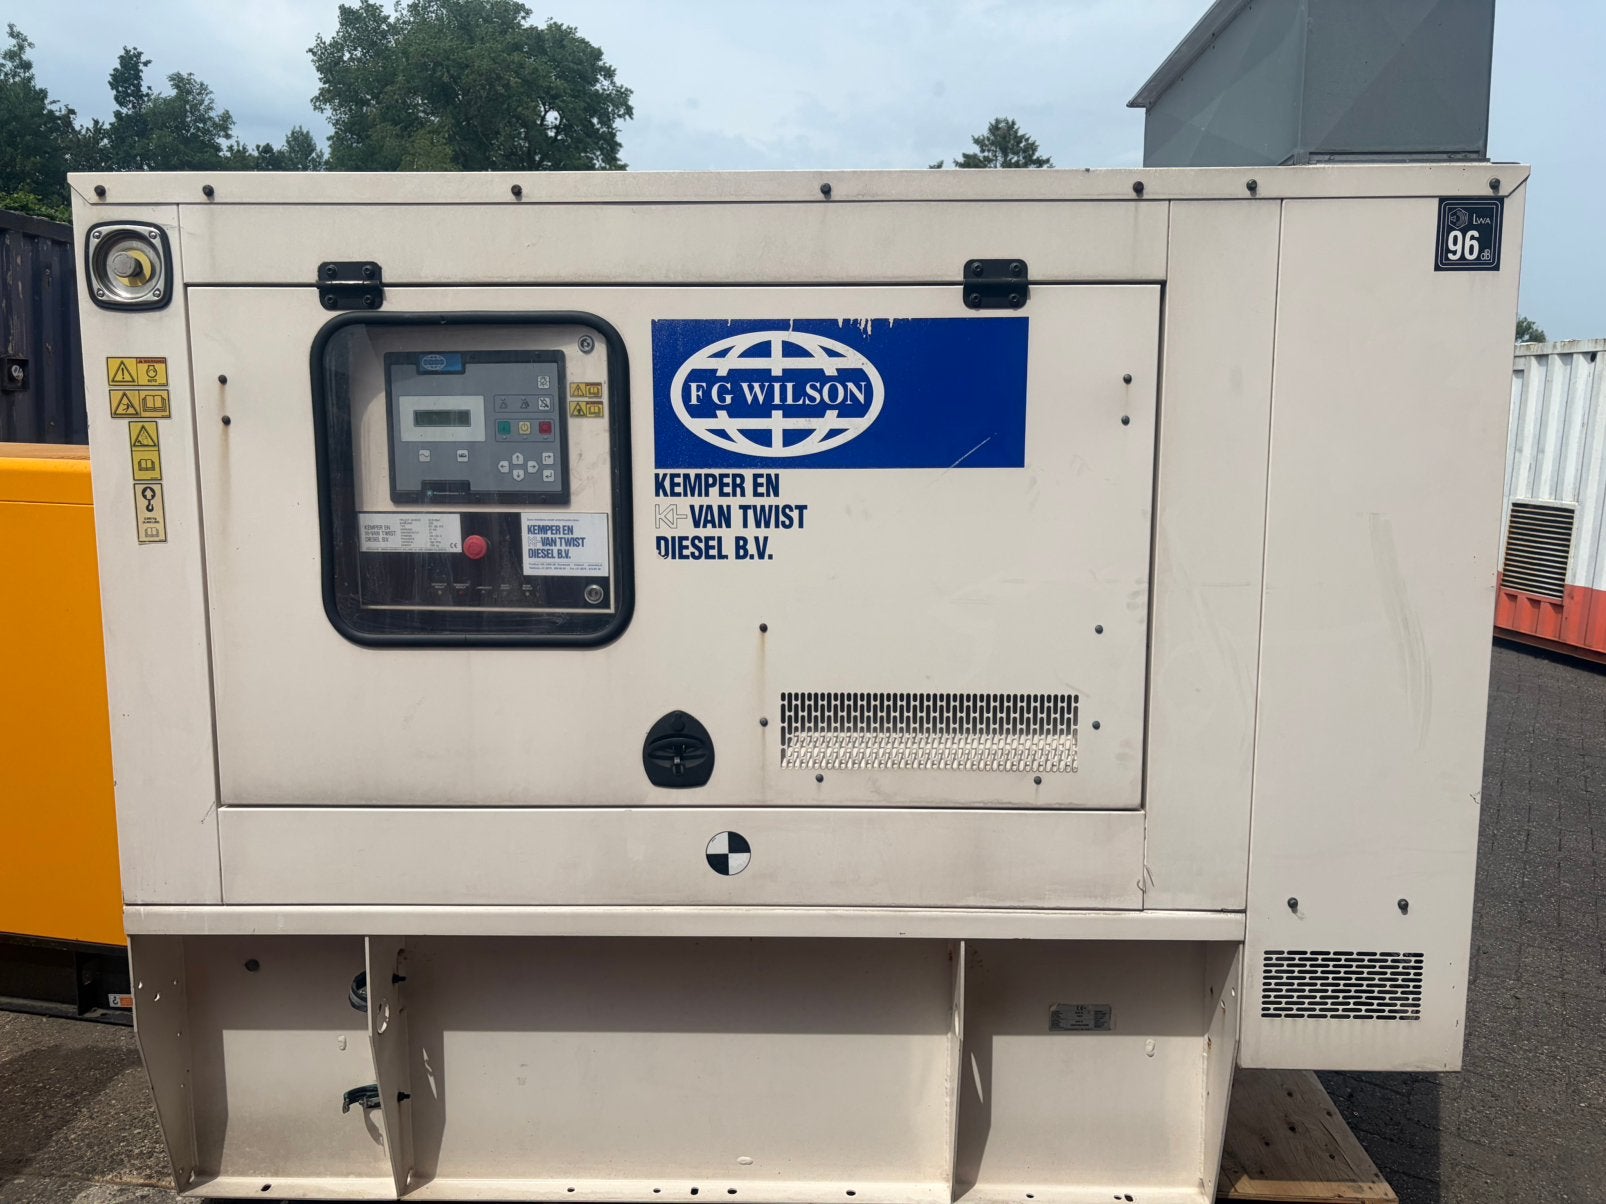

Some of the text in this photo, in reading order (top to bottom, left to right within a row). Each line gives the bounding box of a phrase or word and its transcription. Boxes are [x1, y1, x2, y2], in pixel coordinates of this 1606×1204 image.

[1447, 230, 1480, 261] 96
[741, 382, 866, 405] WILSON
[655, 473, 780, 498] KEMPER EN
[690, 504, 808, 530] VAN TWIST
[527, 524, 574, 535] KEMPER EN
[541, 536, 586, 547] VAN TWIST
[528, 548, 571, 559] DIESEL B.V.
[656, 535, 774, 560] DIESEL B.V.
